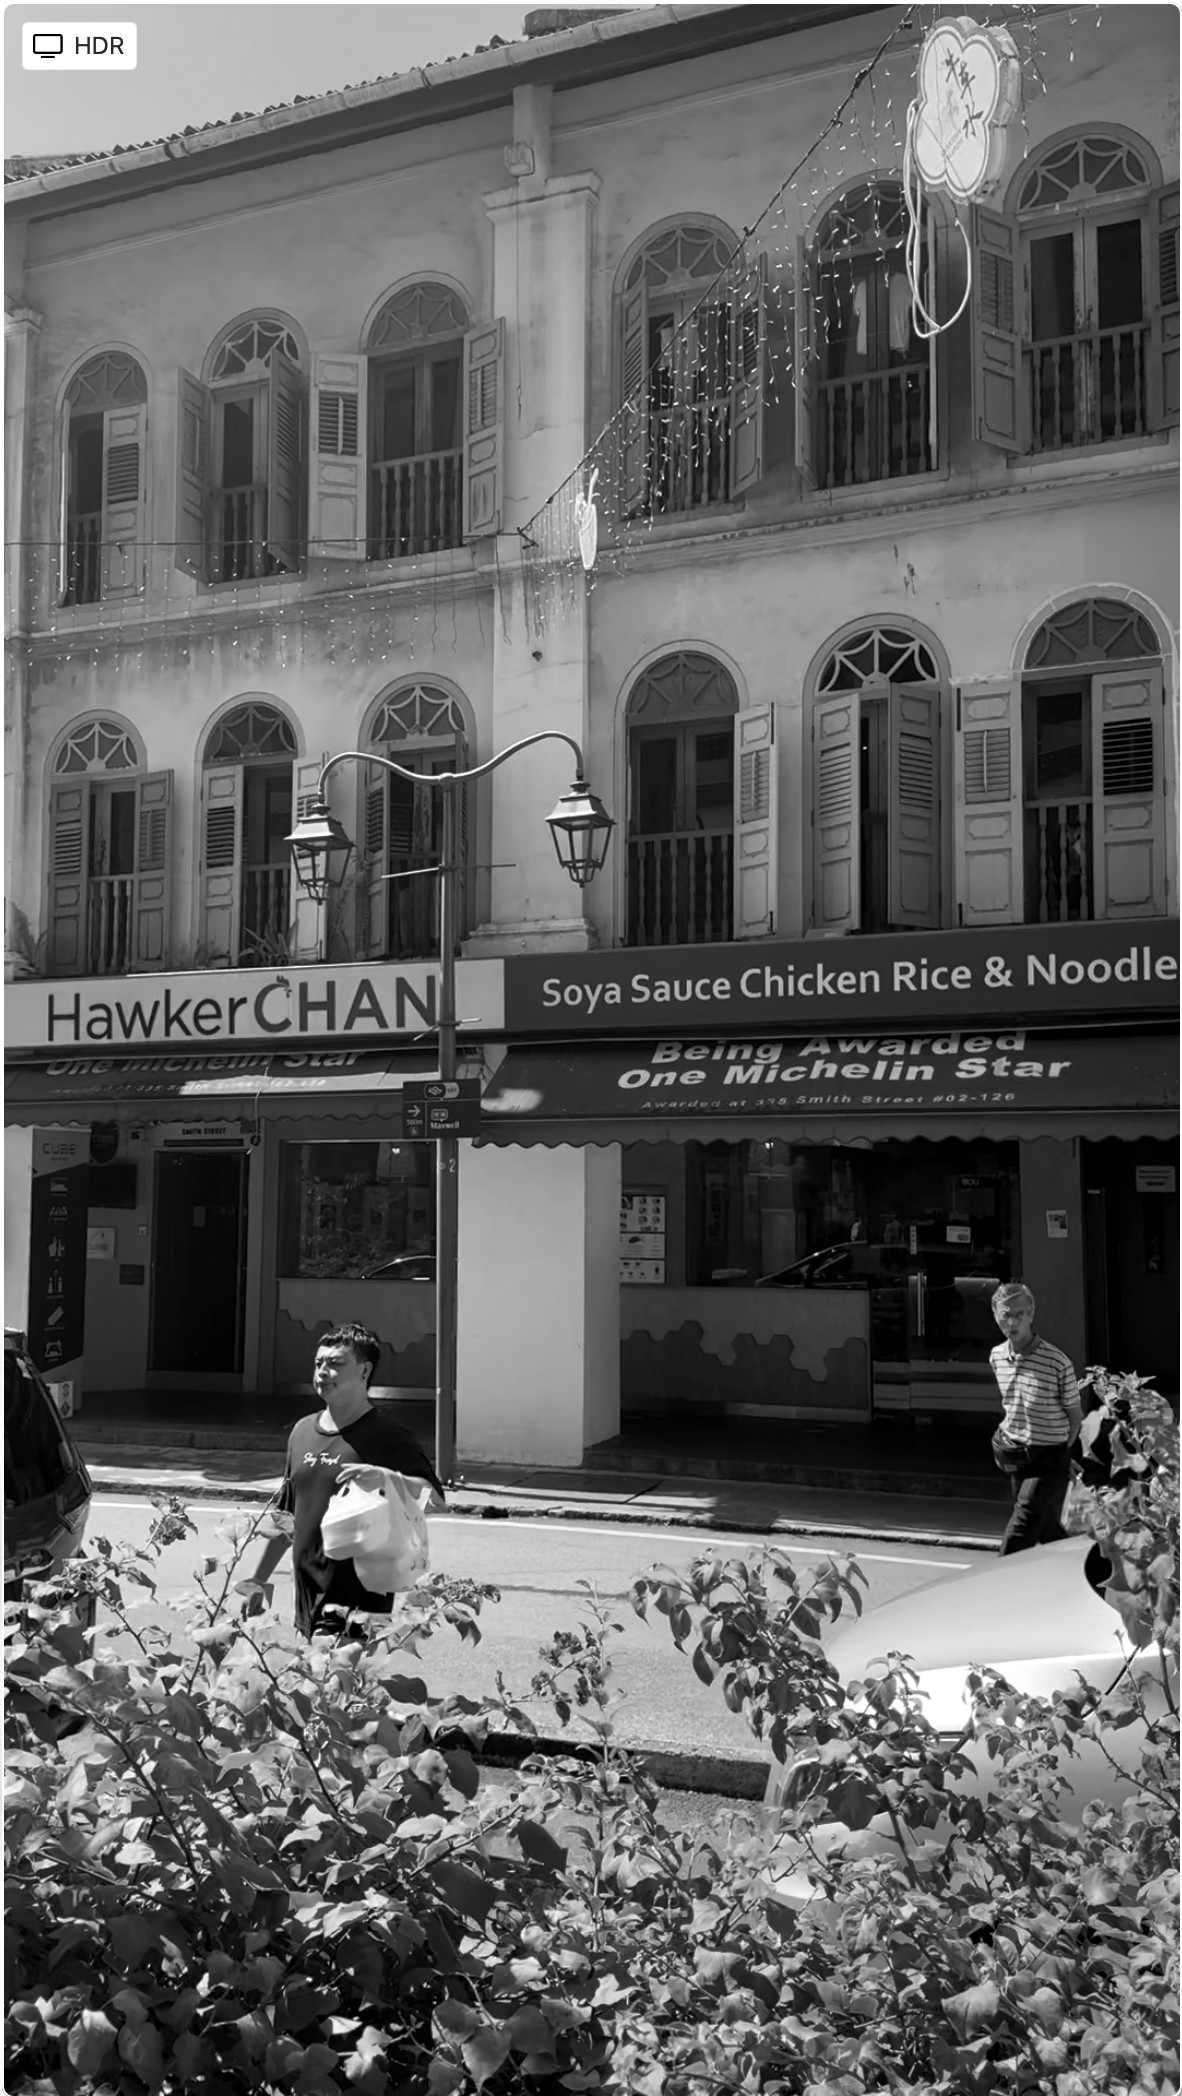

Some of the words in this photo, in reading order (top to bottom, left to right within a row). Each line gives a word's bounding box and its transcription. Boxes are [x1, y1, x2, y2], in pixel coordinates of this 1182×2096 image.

[542, 978, 622, 1015] Soya
[631, 974, 732, 1003] Sauce
[740, 963, 881, 998] Chicken
[893, 958, 972, 992] Rice
[984, 955, 1014, 988] &
[1027, 946, 1179, 986] Noodle
[651, 1040, 784, 1064] Being
[798, 1032, 1027, 1057] Awarded
[617, 1069, 707, 1089] One
[722, 1059, 935, 1085] Michelin
[954, 1056, 1072, 1079] Star
[641, 1099, 721, 1110] Awarded
[796, 1094, 852, 1104] Smith
[861, 1095, 923, 1104] Street
[932, 1092, 1015, 1104] #02-126
[430, 1120, 460, 1130] Maxwell
